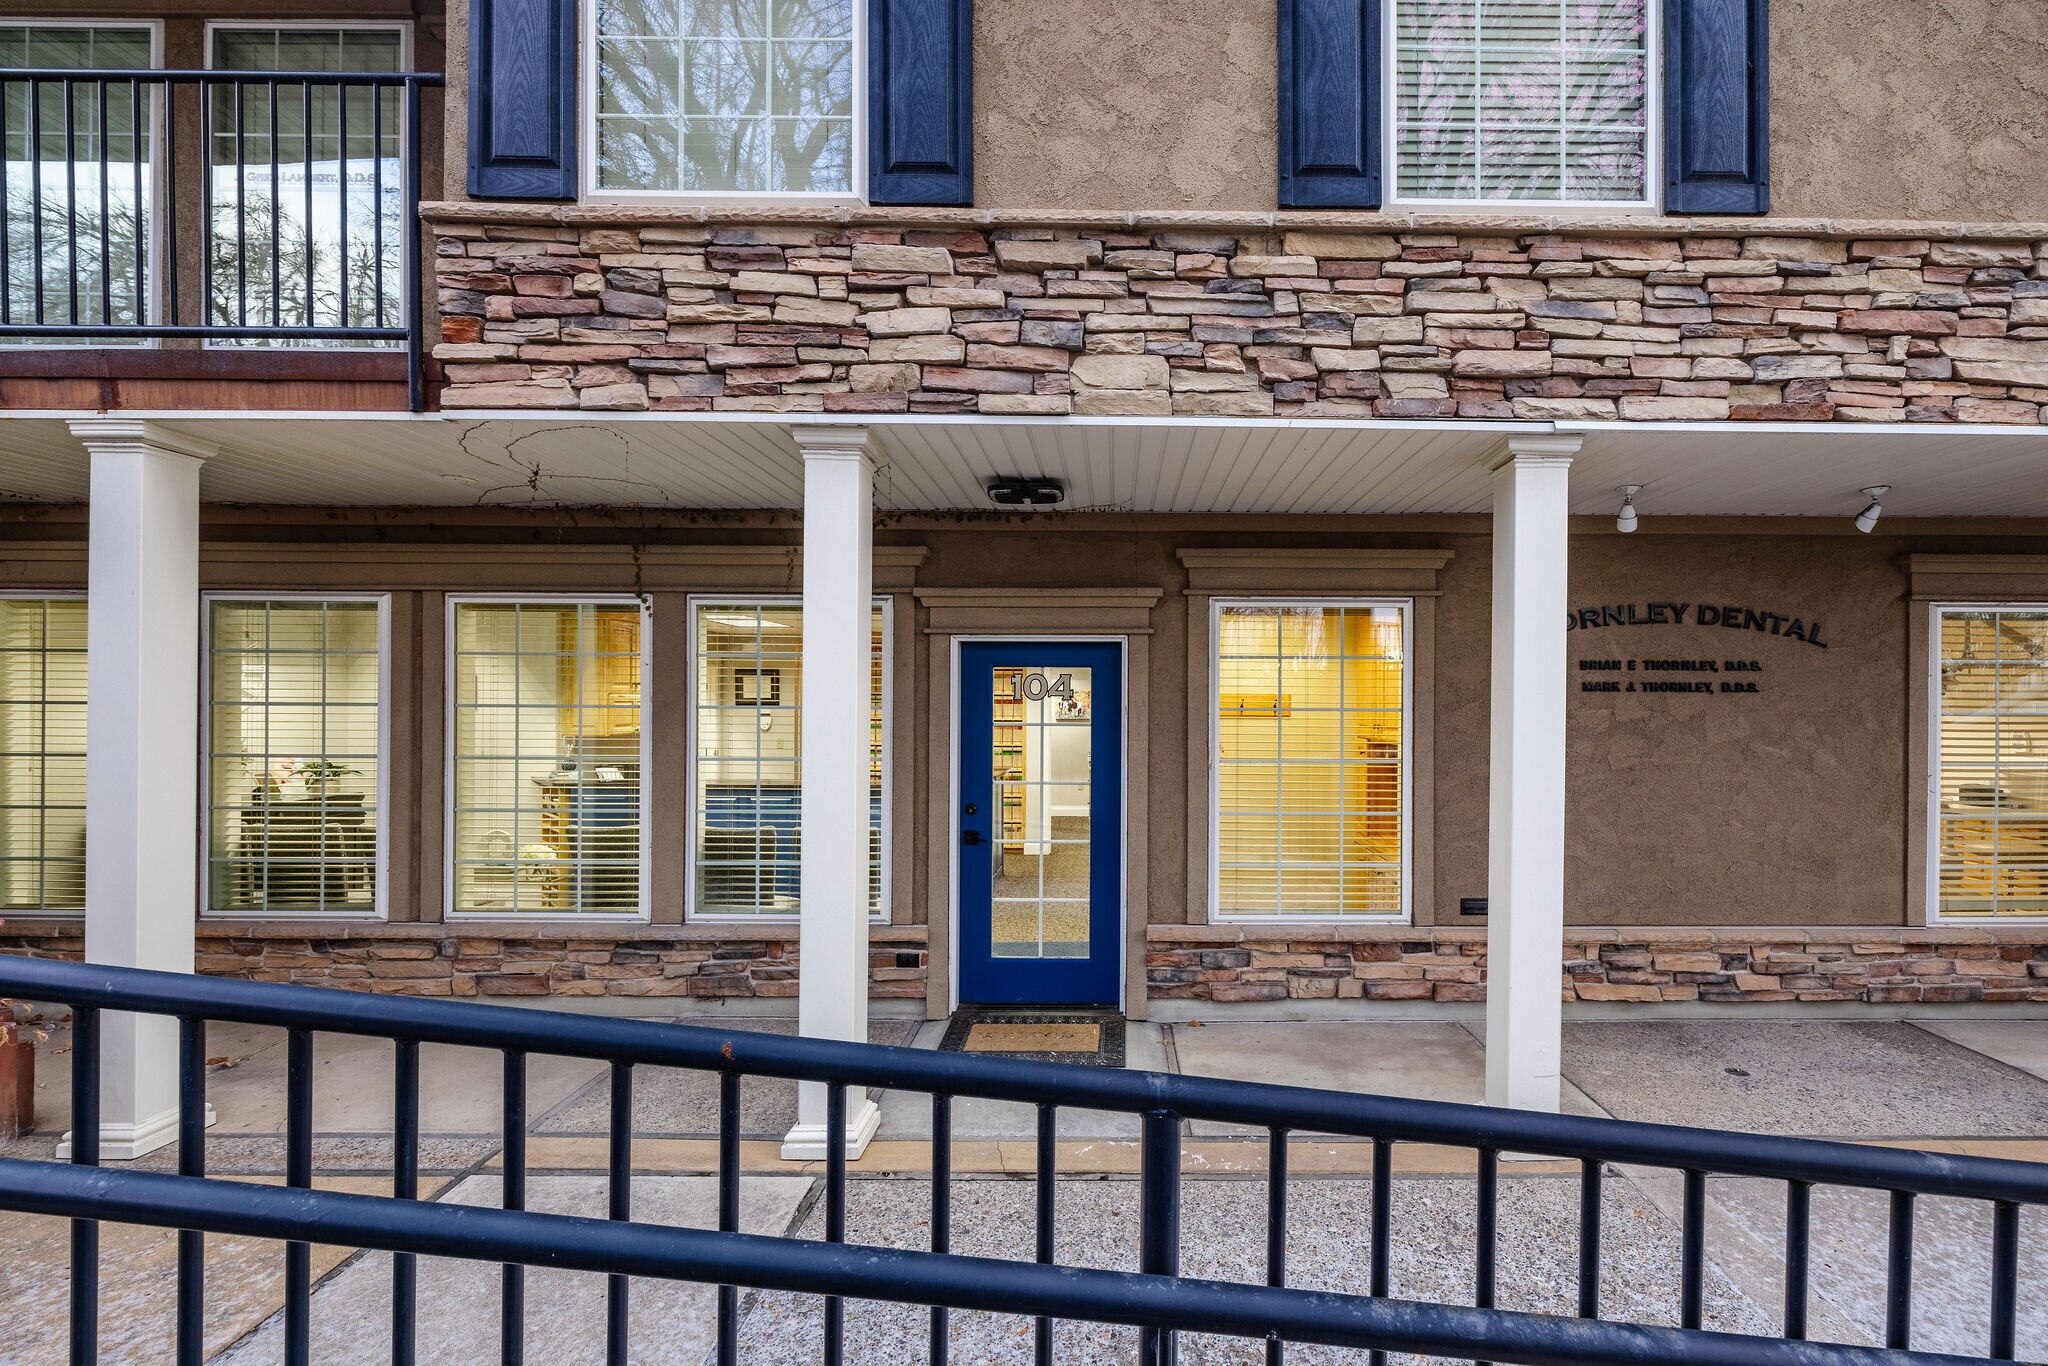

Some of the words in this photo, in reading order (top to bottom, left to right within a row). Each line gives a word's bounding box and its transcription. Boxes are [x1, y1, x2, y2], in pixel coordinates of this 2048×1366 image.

[1696, 603, 1828, 648] DENTAL
[1579, 659, 1621, 671] BRIAN
[1643, 659, 1719, 673] THORNLEY,
[1724, 660, 1762, 671] D.D.S.
[1011, 672, 1074, 701] 104
[1581, 681, 1621, 693] MARK
[1640, 681, 1714, 695] THORNLEY,
[1720, 682, 1760, 693] D.D.S.
